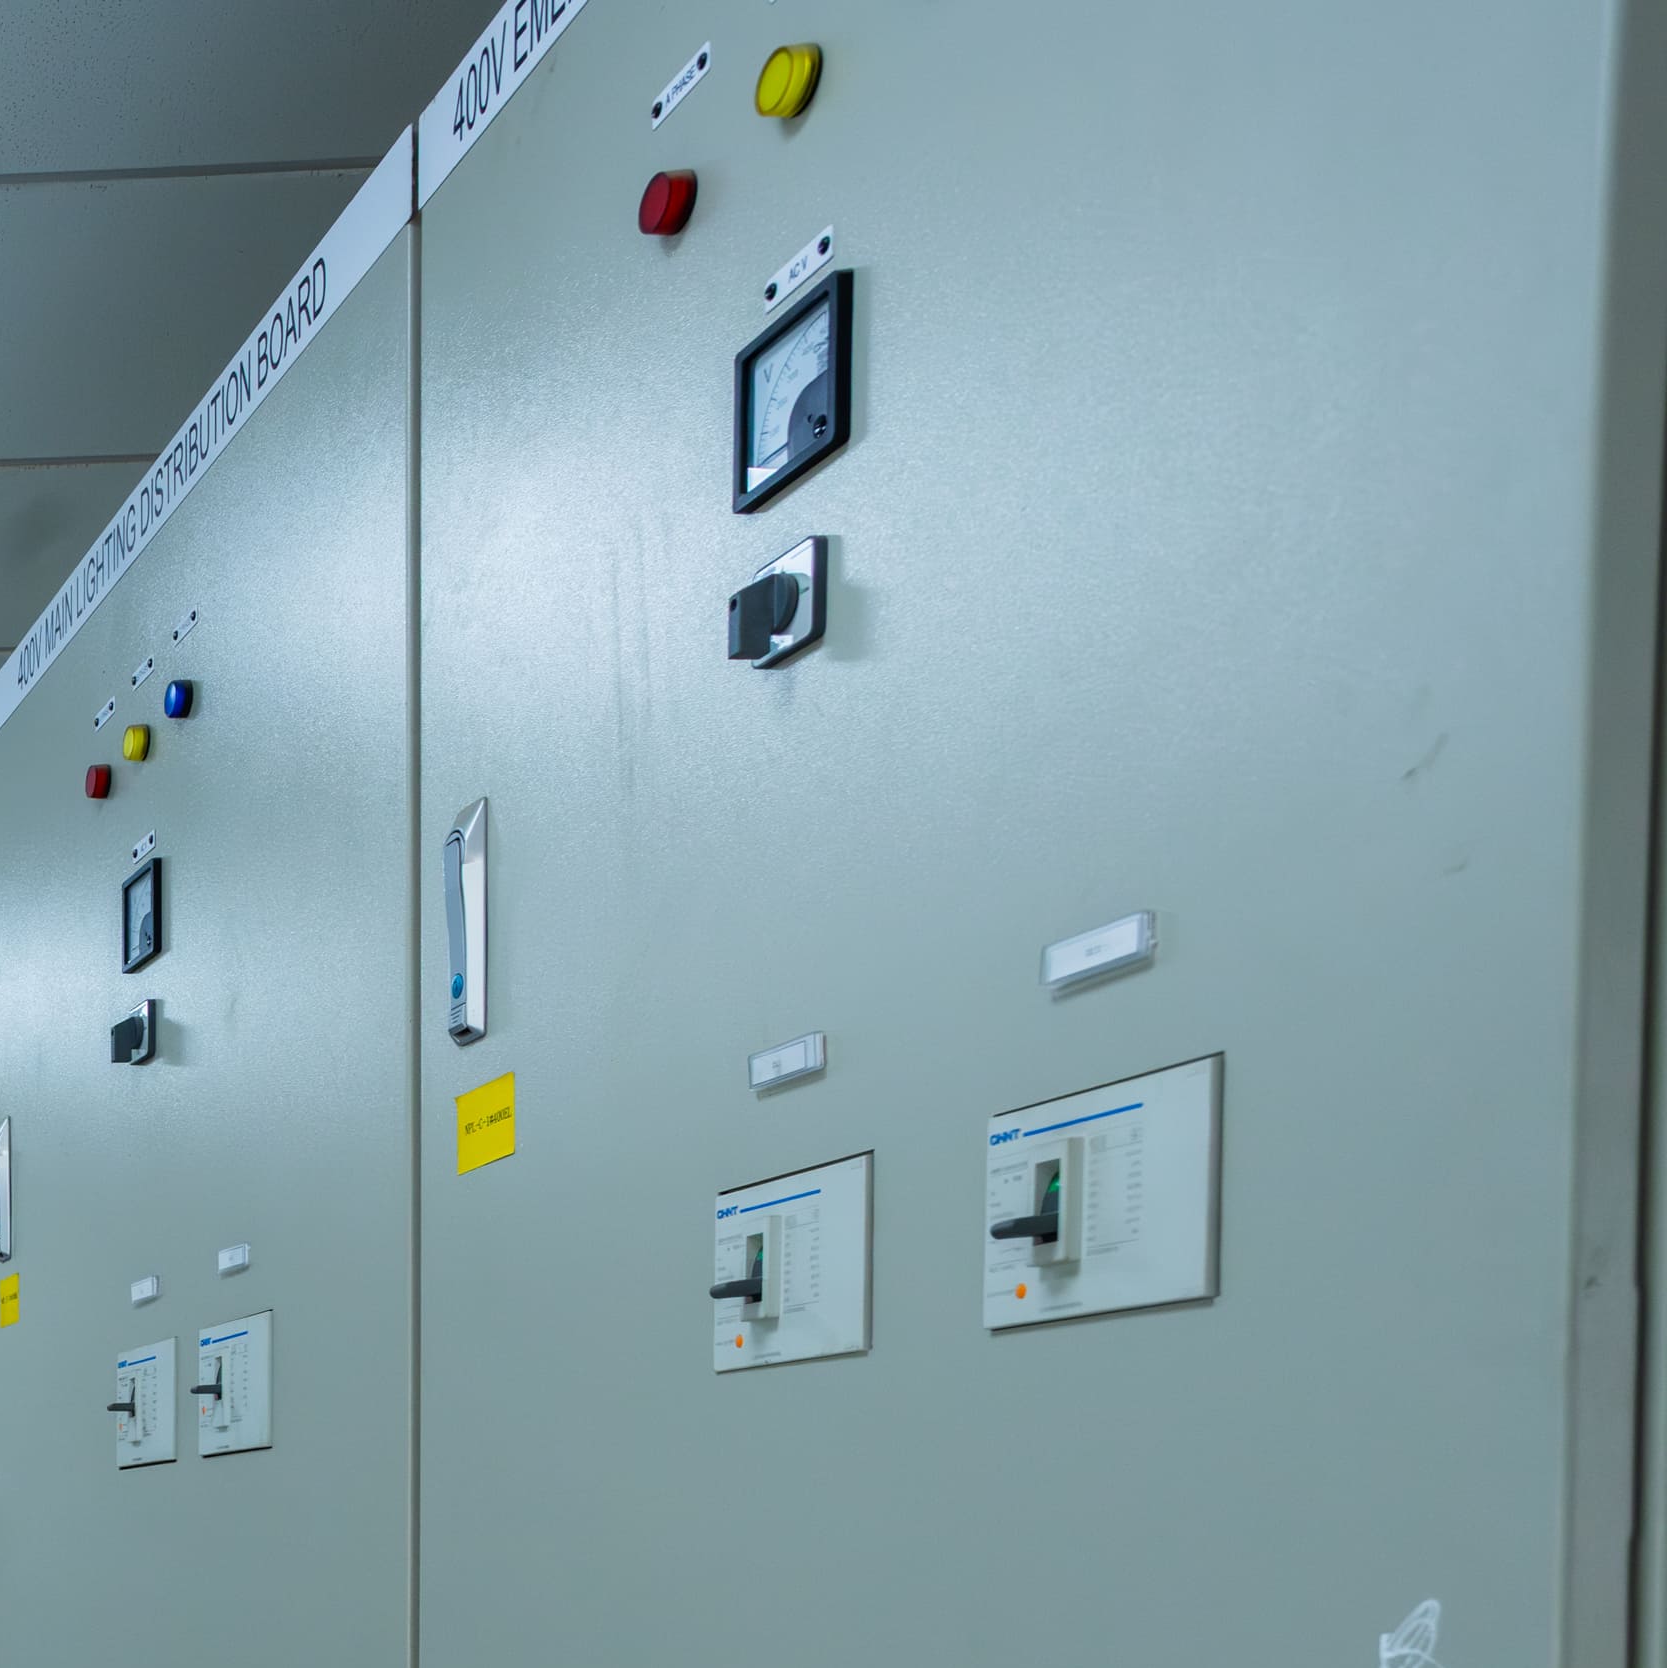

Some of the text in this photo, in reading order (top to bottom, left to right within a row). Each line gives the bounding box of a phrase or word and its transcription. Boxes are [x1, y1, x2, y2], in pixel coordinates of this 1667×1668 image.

[453, 20, 507, 141] 400V
[16, 256, 327, 691] 400V MAIN LIGHTING DISTRIBUTION BOARD
